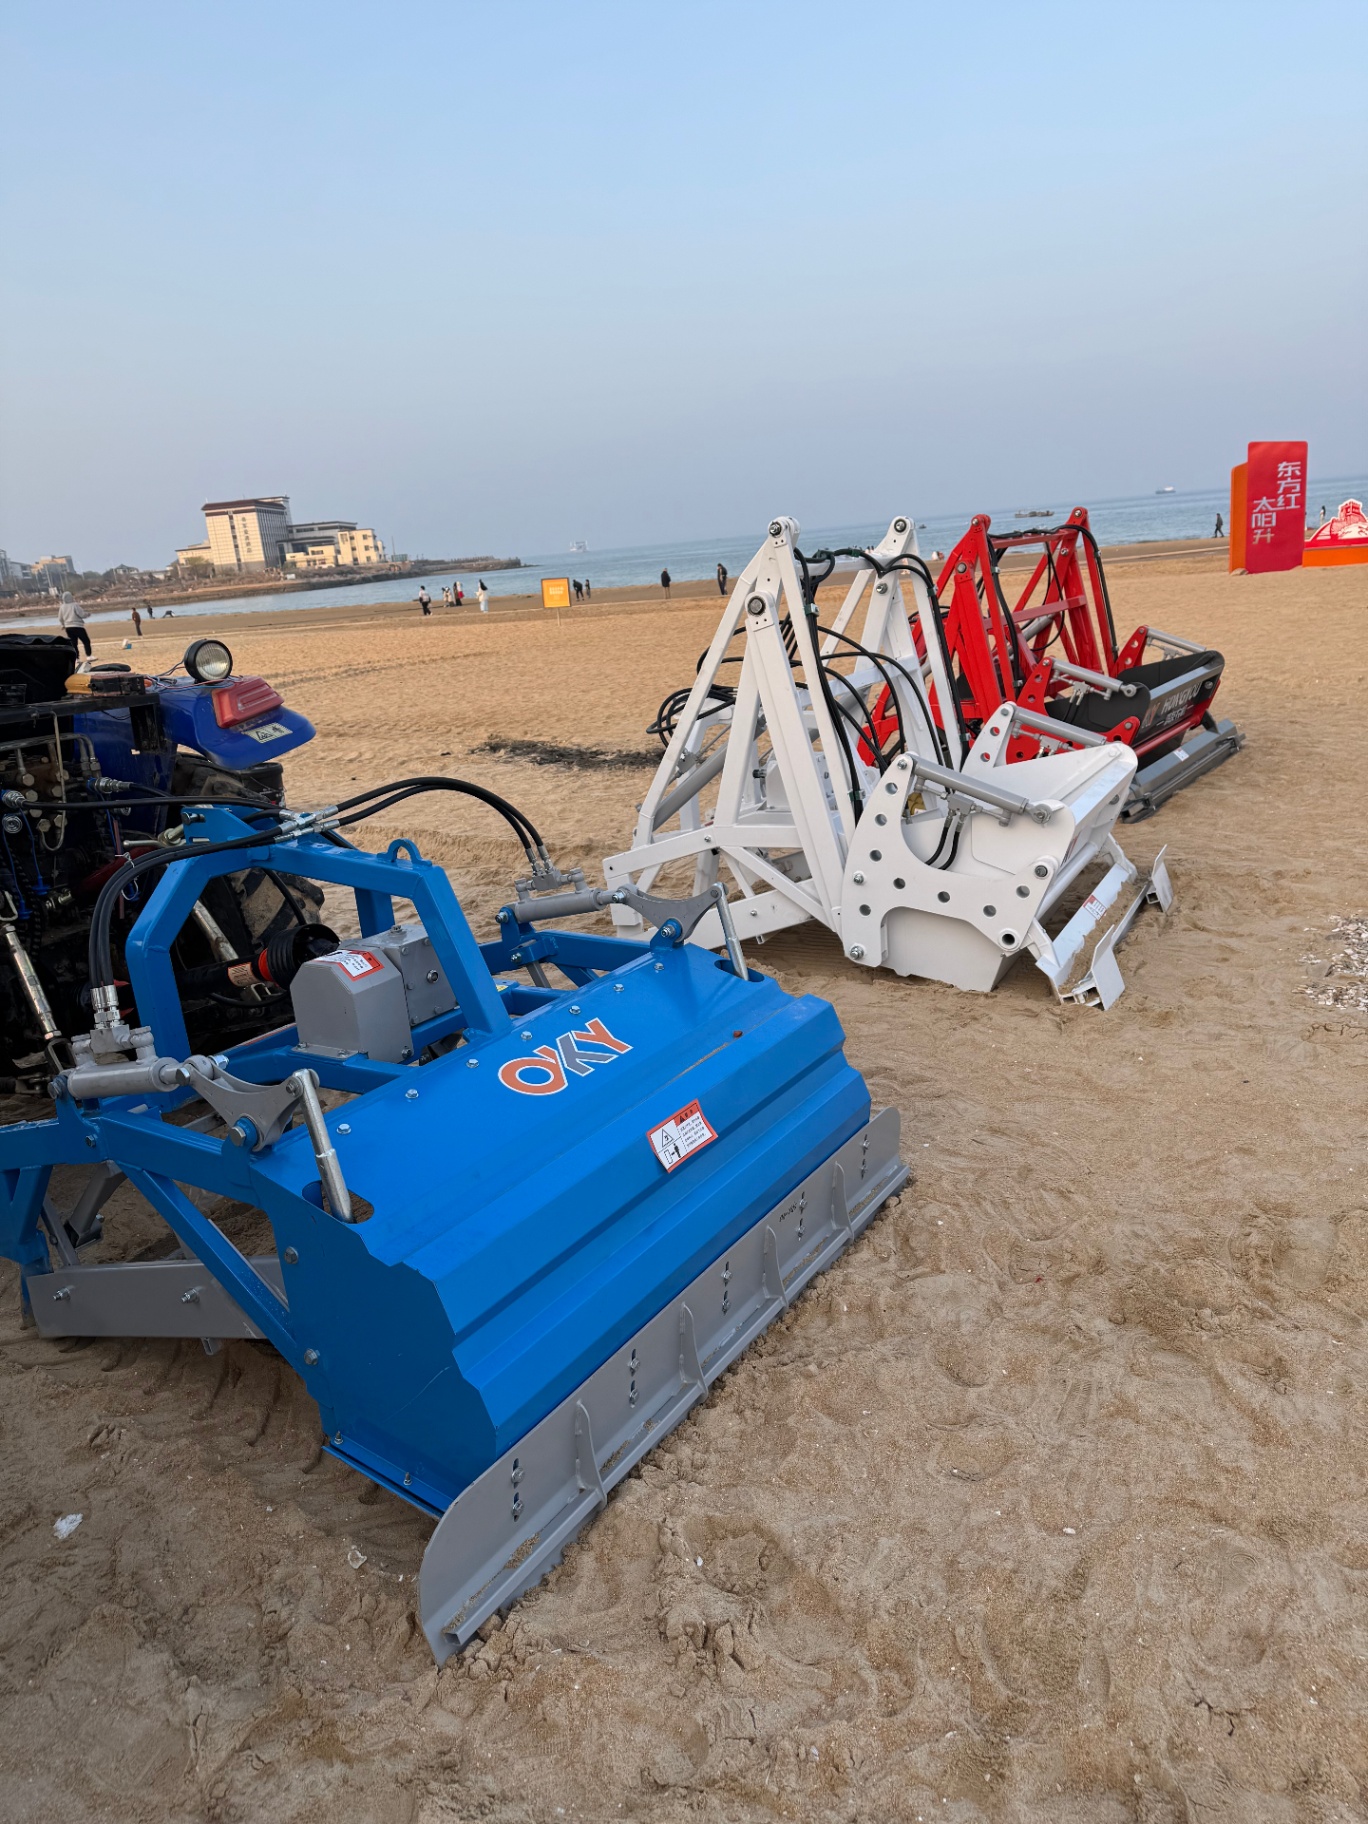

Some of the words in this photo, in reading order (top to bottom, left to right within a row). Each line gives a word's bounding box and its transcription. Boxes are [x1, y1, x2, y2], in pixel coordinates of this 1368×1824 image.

[1277, 461, 1301, 510] 东方红
[1251, 496, 1277, 545] 太阳升
